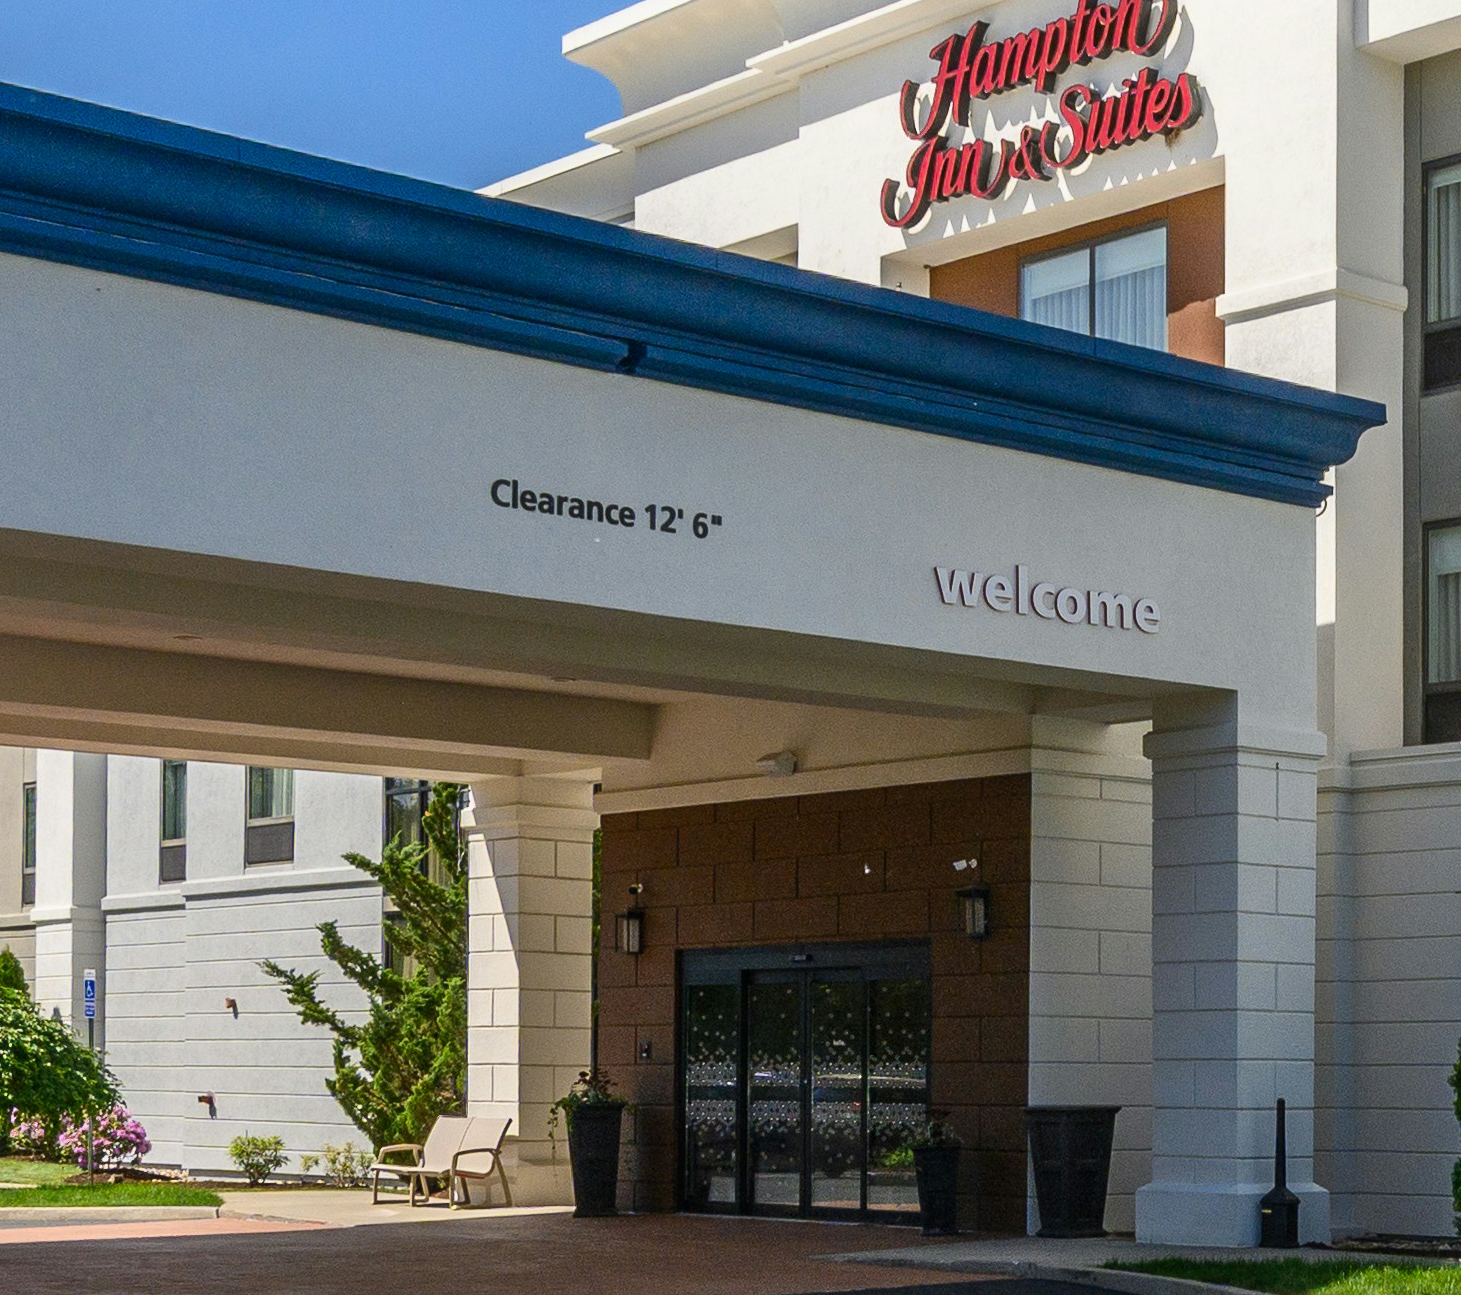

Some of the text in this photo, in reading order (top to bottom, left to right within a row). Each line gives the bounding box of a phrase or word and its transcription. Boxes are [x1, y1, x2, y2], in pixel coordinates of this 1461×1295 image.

[880, 66, 1201, 229] Inn & Suites
[490, 478, 723, 539] Clearance 12' 6"
[934, 564, 1162, 635] welcome
